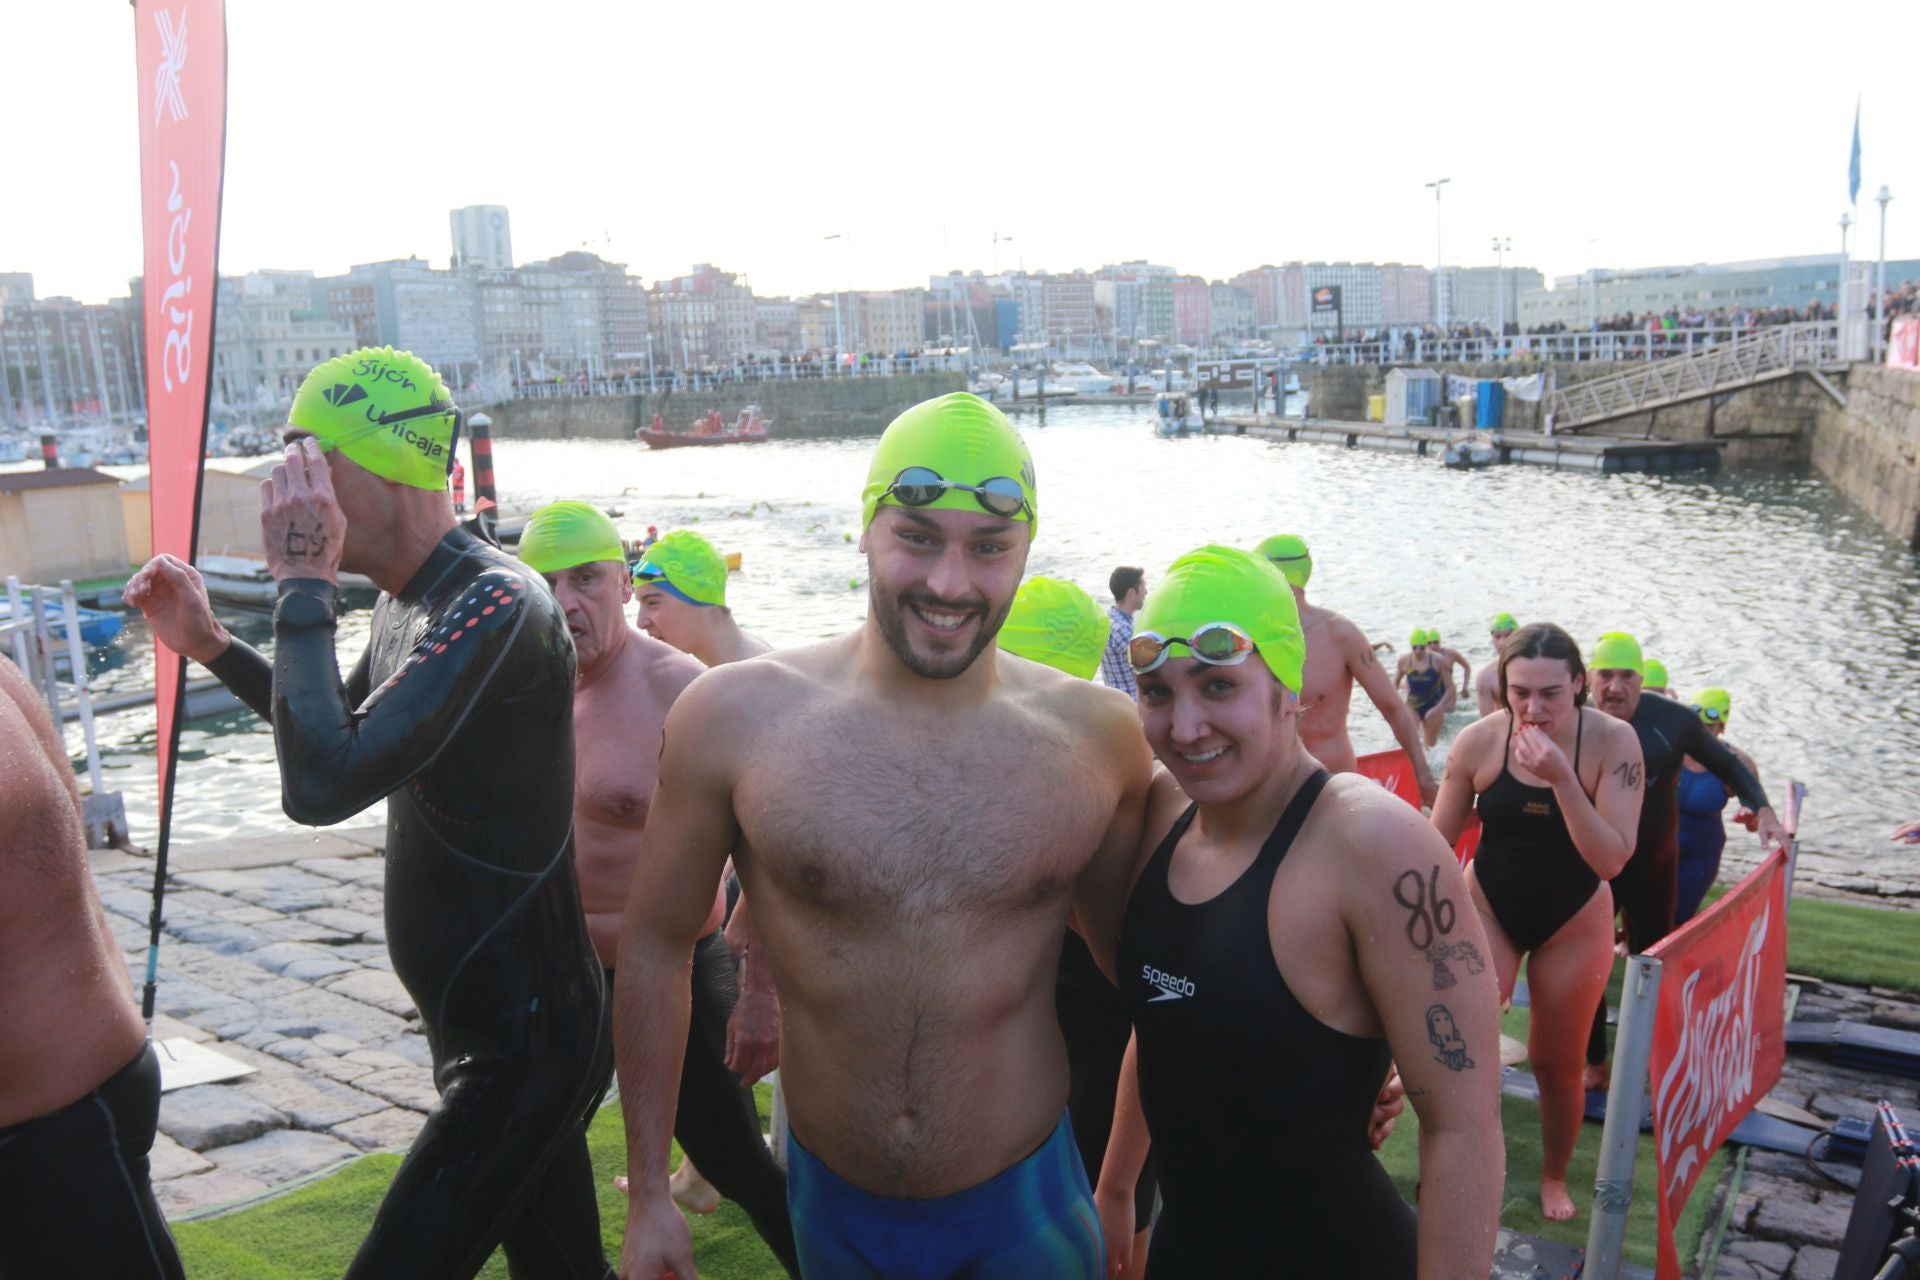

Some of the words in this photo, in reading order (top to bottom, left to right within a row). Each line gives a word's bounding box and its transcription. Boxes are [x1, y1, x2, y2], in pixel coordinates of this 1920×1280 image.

[352, 359, 417, 392] gijón
[1393, 865, 1456, 951] 86
[1142, 964, 1196, 997] speedo
